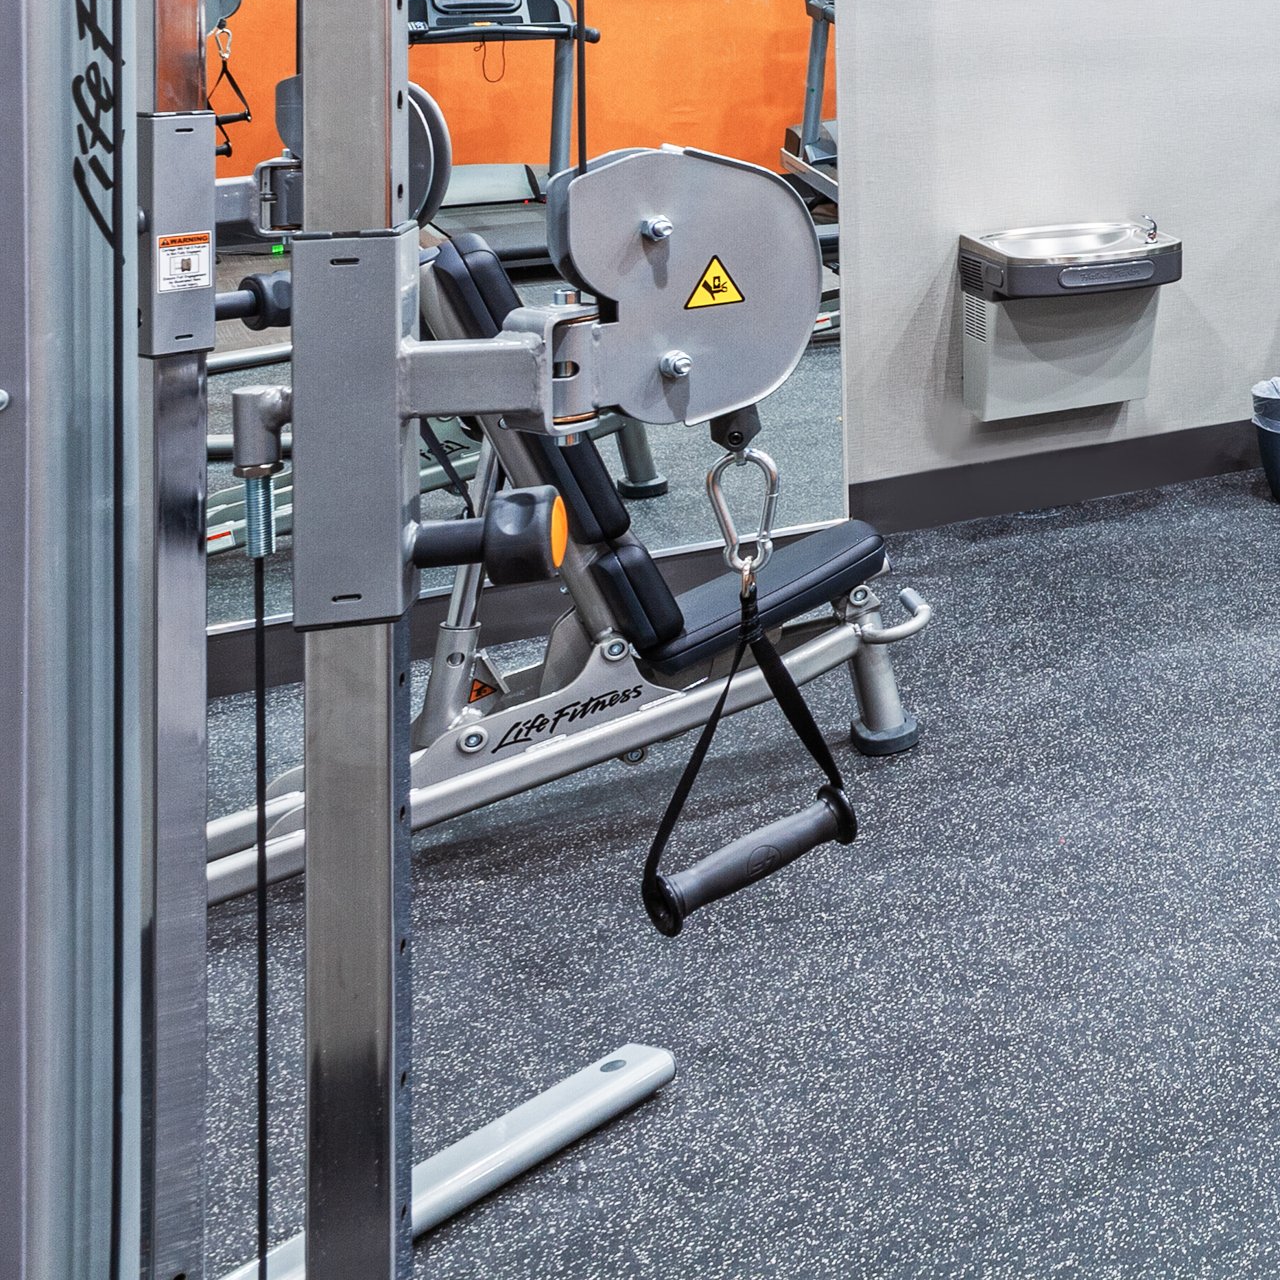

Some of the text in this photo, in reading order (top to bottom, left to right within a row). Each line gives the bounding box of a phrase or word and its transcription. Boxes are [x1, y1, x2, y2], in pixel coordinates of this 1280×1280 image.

[71, 61, 126, 265] Life
[170, 235, 208, 245] WARNING
[491, 684, 643, 754] Life Fitness
